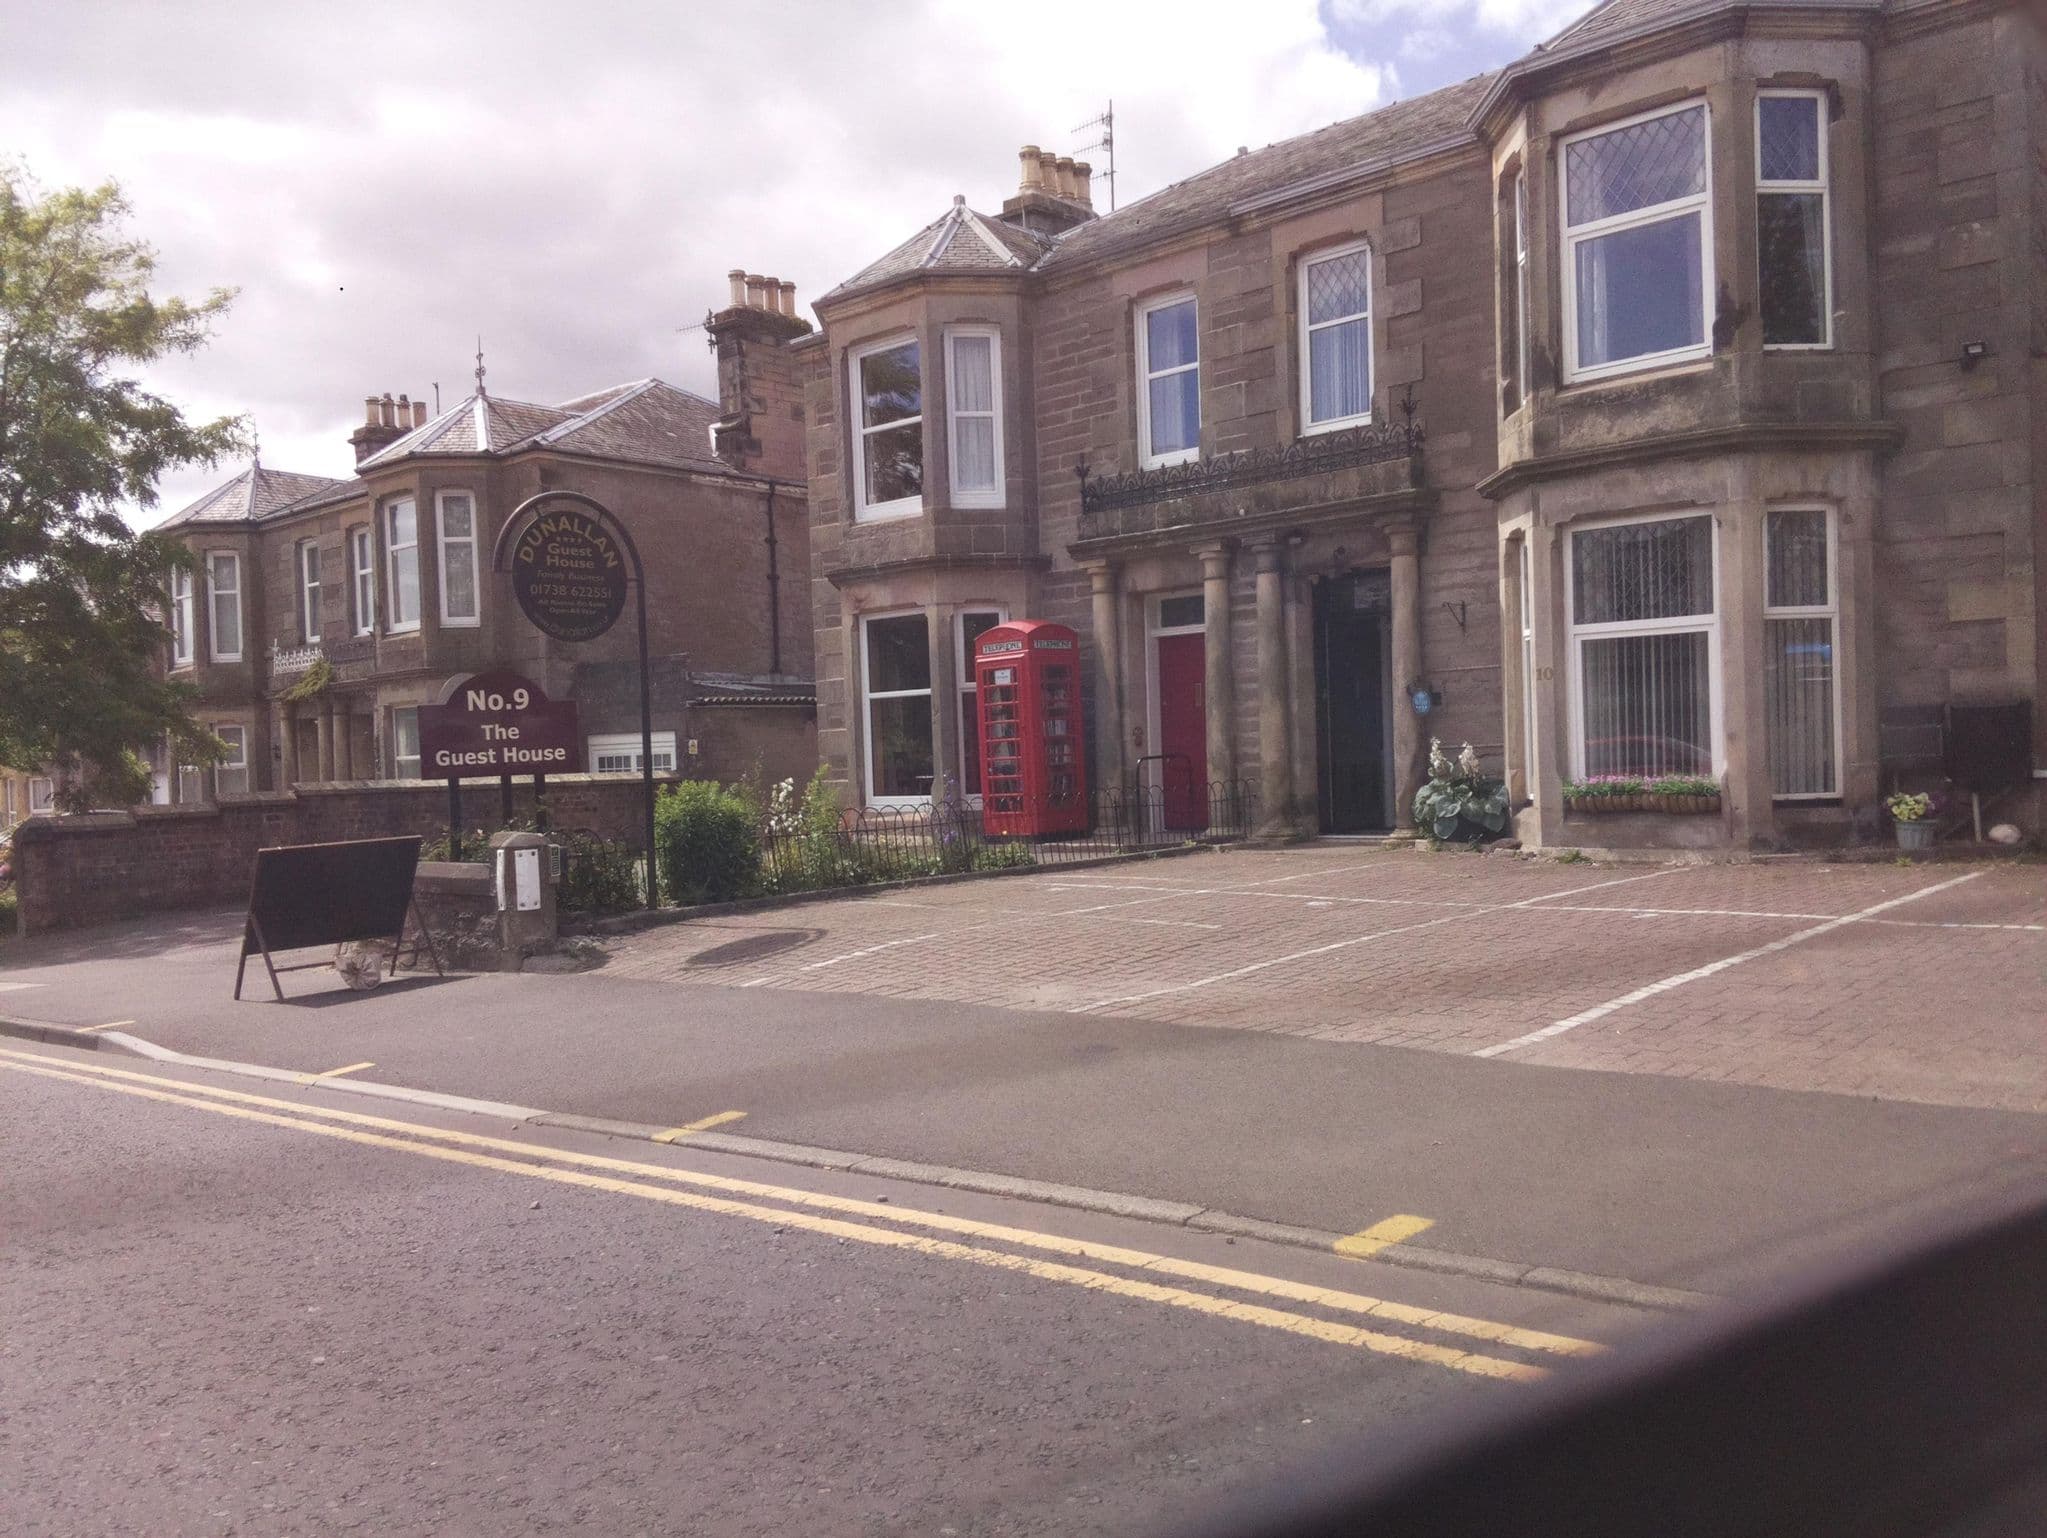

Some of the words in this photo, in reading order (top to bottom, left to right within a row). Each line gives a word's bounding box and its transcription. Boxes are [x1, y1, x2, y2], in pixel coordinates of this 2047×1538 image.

[519, 515, 618, 569] DUNALLAN
[547, 543, 593, 557] Guest
[546, 555, 595, 569] House
[530, 585, 567, 595] 01738
[571, 587, 612, 599] 622551
[984, 641, 1021, 653] TELEPHONE
[1536, 666, 1553, 681] 10
[466, 688, 530, 712] No.9
[481, 724, 520, 741] The
[435, 749, 497, 767] Guest
[503, 747, 566, 763] House
